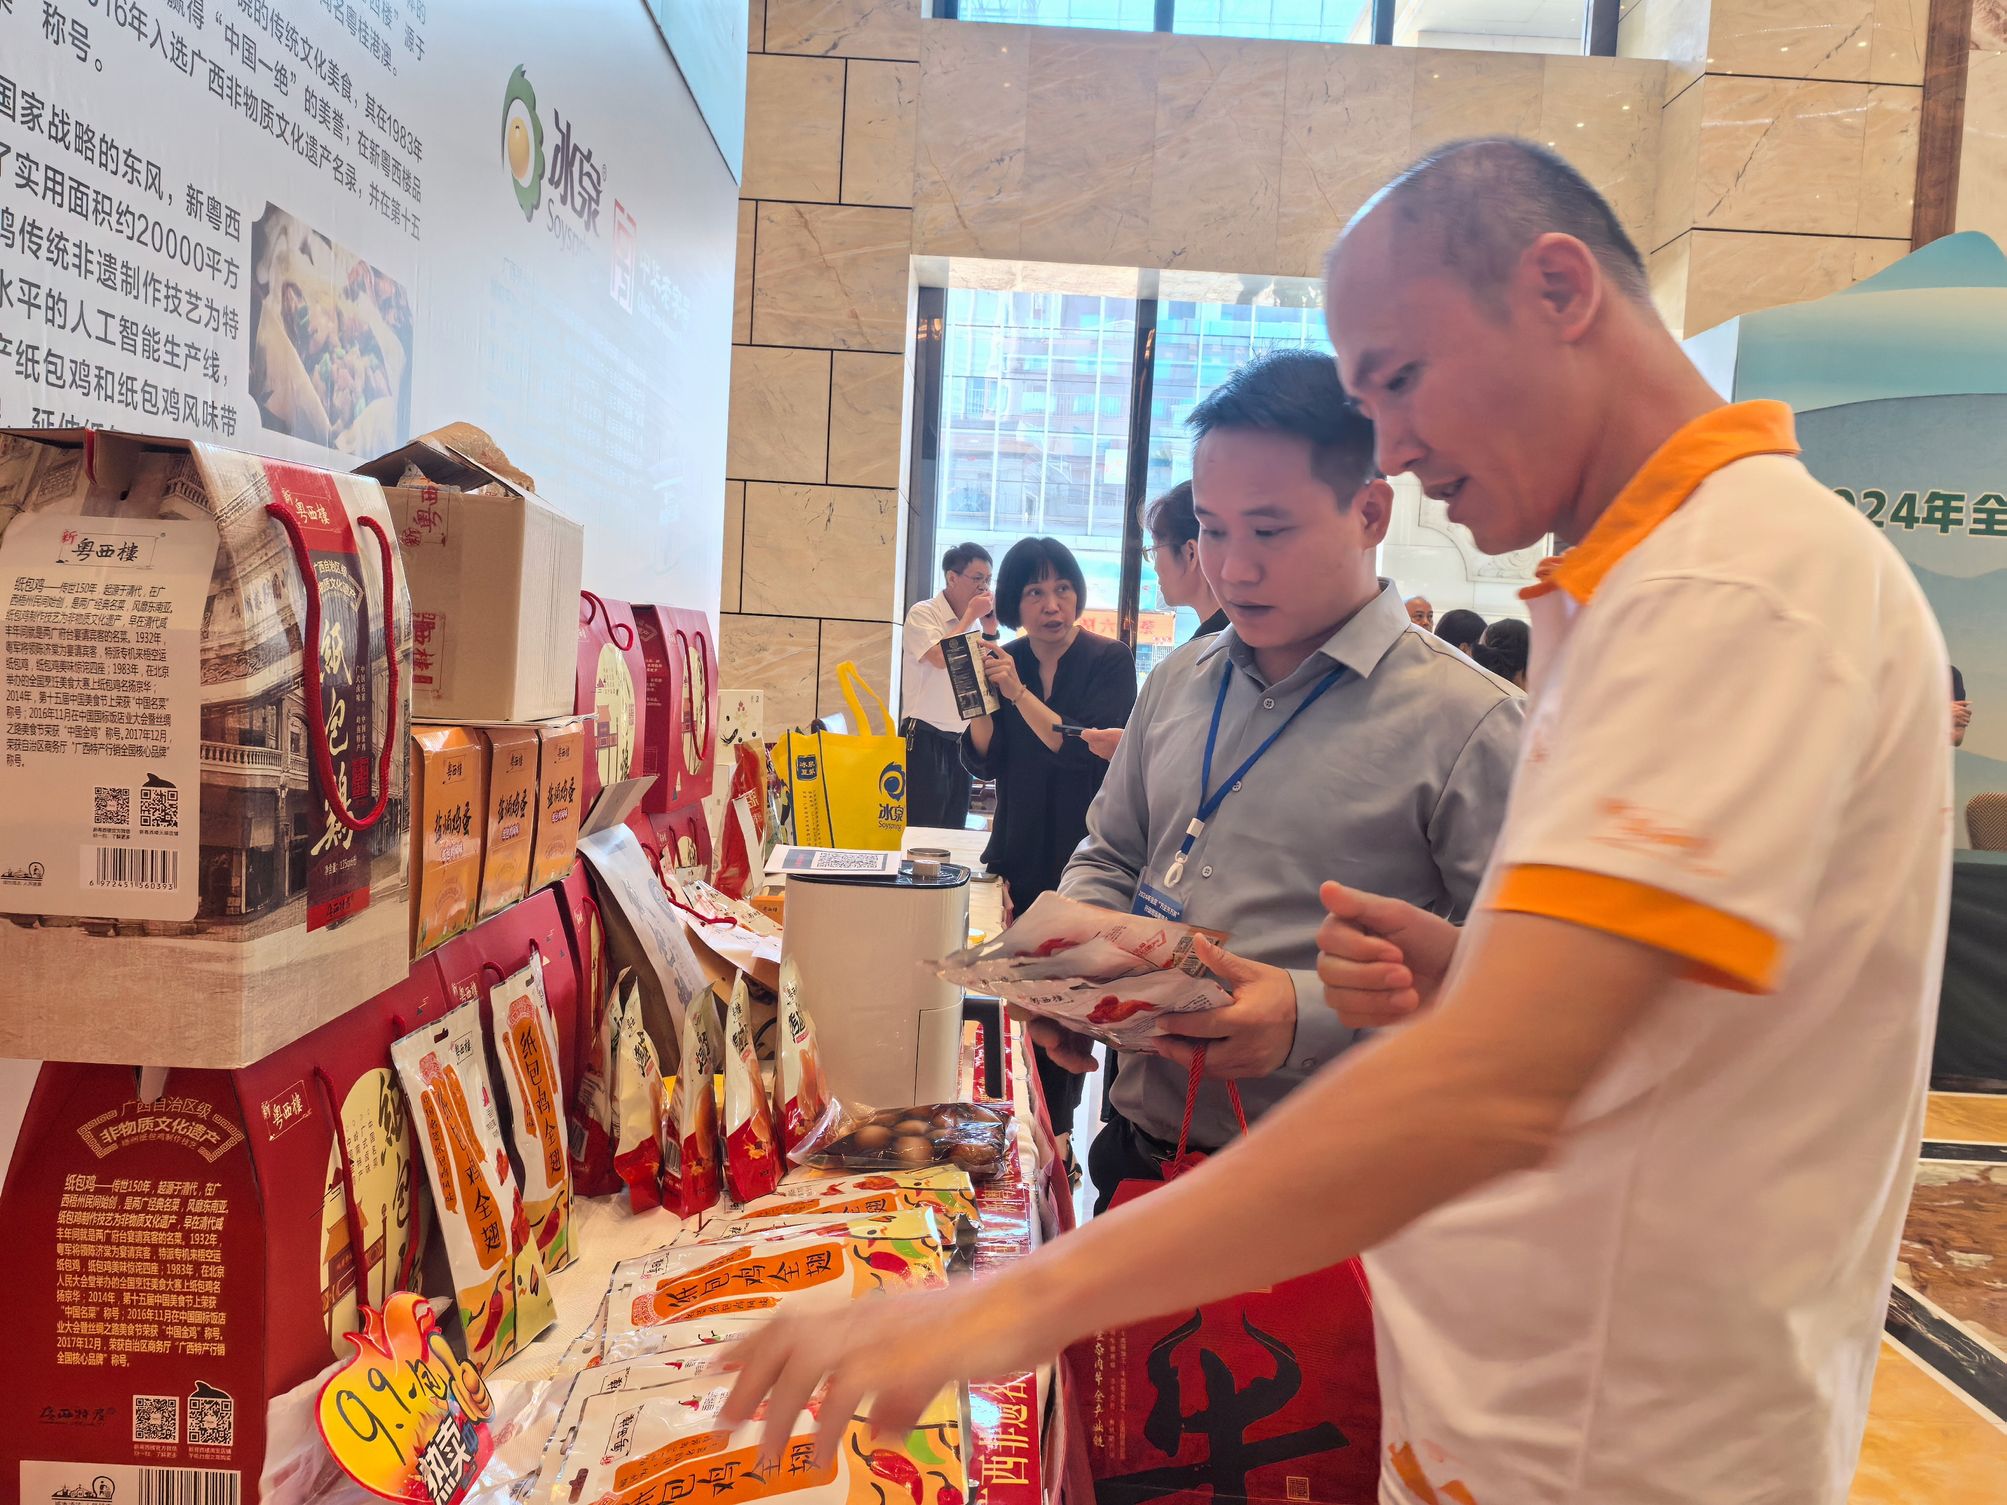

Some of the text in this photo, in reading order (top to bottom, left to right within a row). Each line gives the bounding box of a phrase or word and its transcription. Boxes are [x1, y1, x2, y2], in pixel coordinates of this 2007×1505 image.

[42, 1, 103, 73] 称号。
[88, 0, 421, 241] 16年入选广西非物质文化遗产名录，并在第十五
[99, 1116, 221, 1144] 非物质文化遗产
[667, 1249, 832, 1309] 纸包鸡全翅
